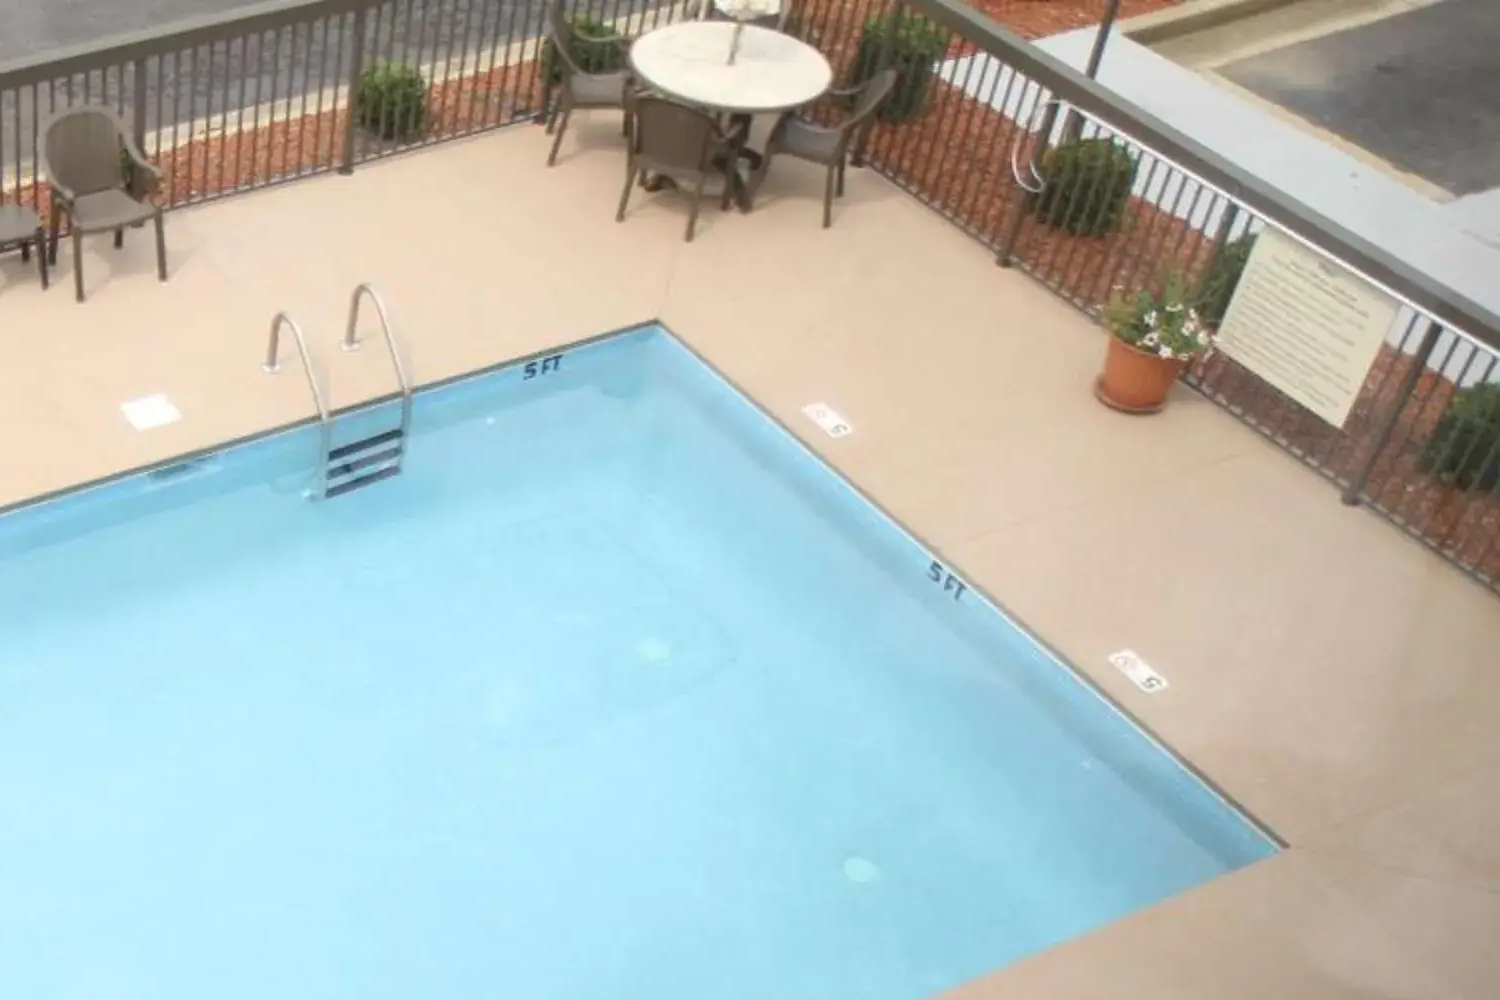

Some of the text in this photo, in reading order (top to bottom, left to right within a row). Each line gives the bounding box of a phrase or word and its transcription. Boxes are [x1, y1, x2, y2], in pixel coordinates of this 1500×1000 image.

[523, 354, 564, 380] 5 FT
[927, 561, 967, 600] 5 FT
